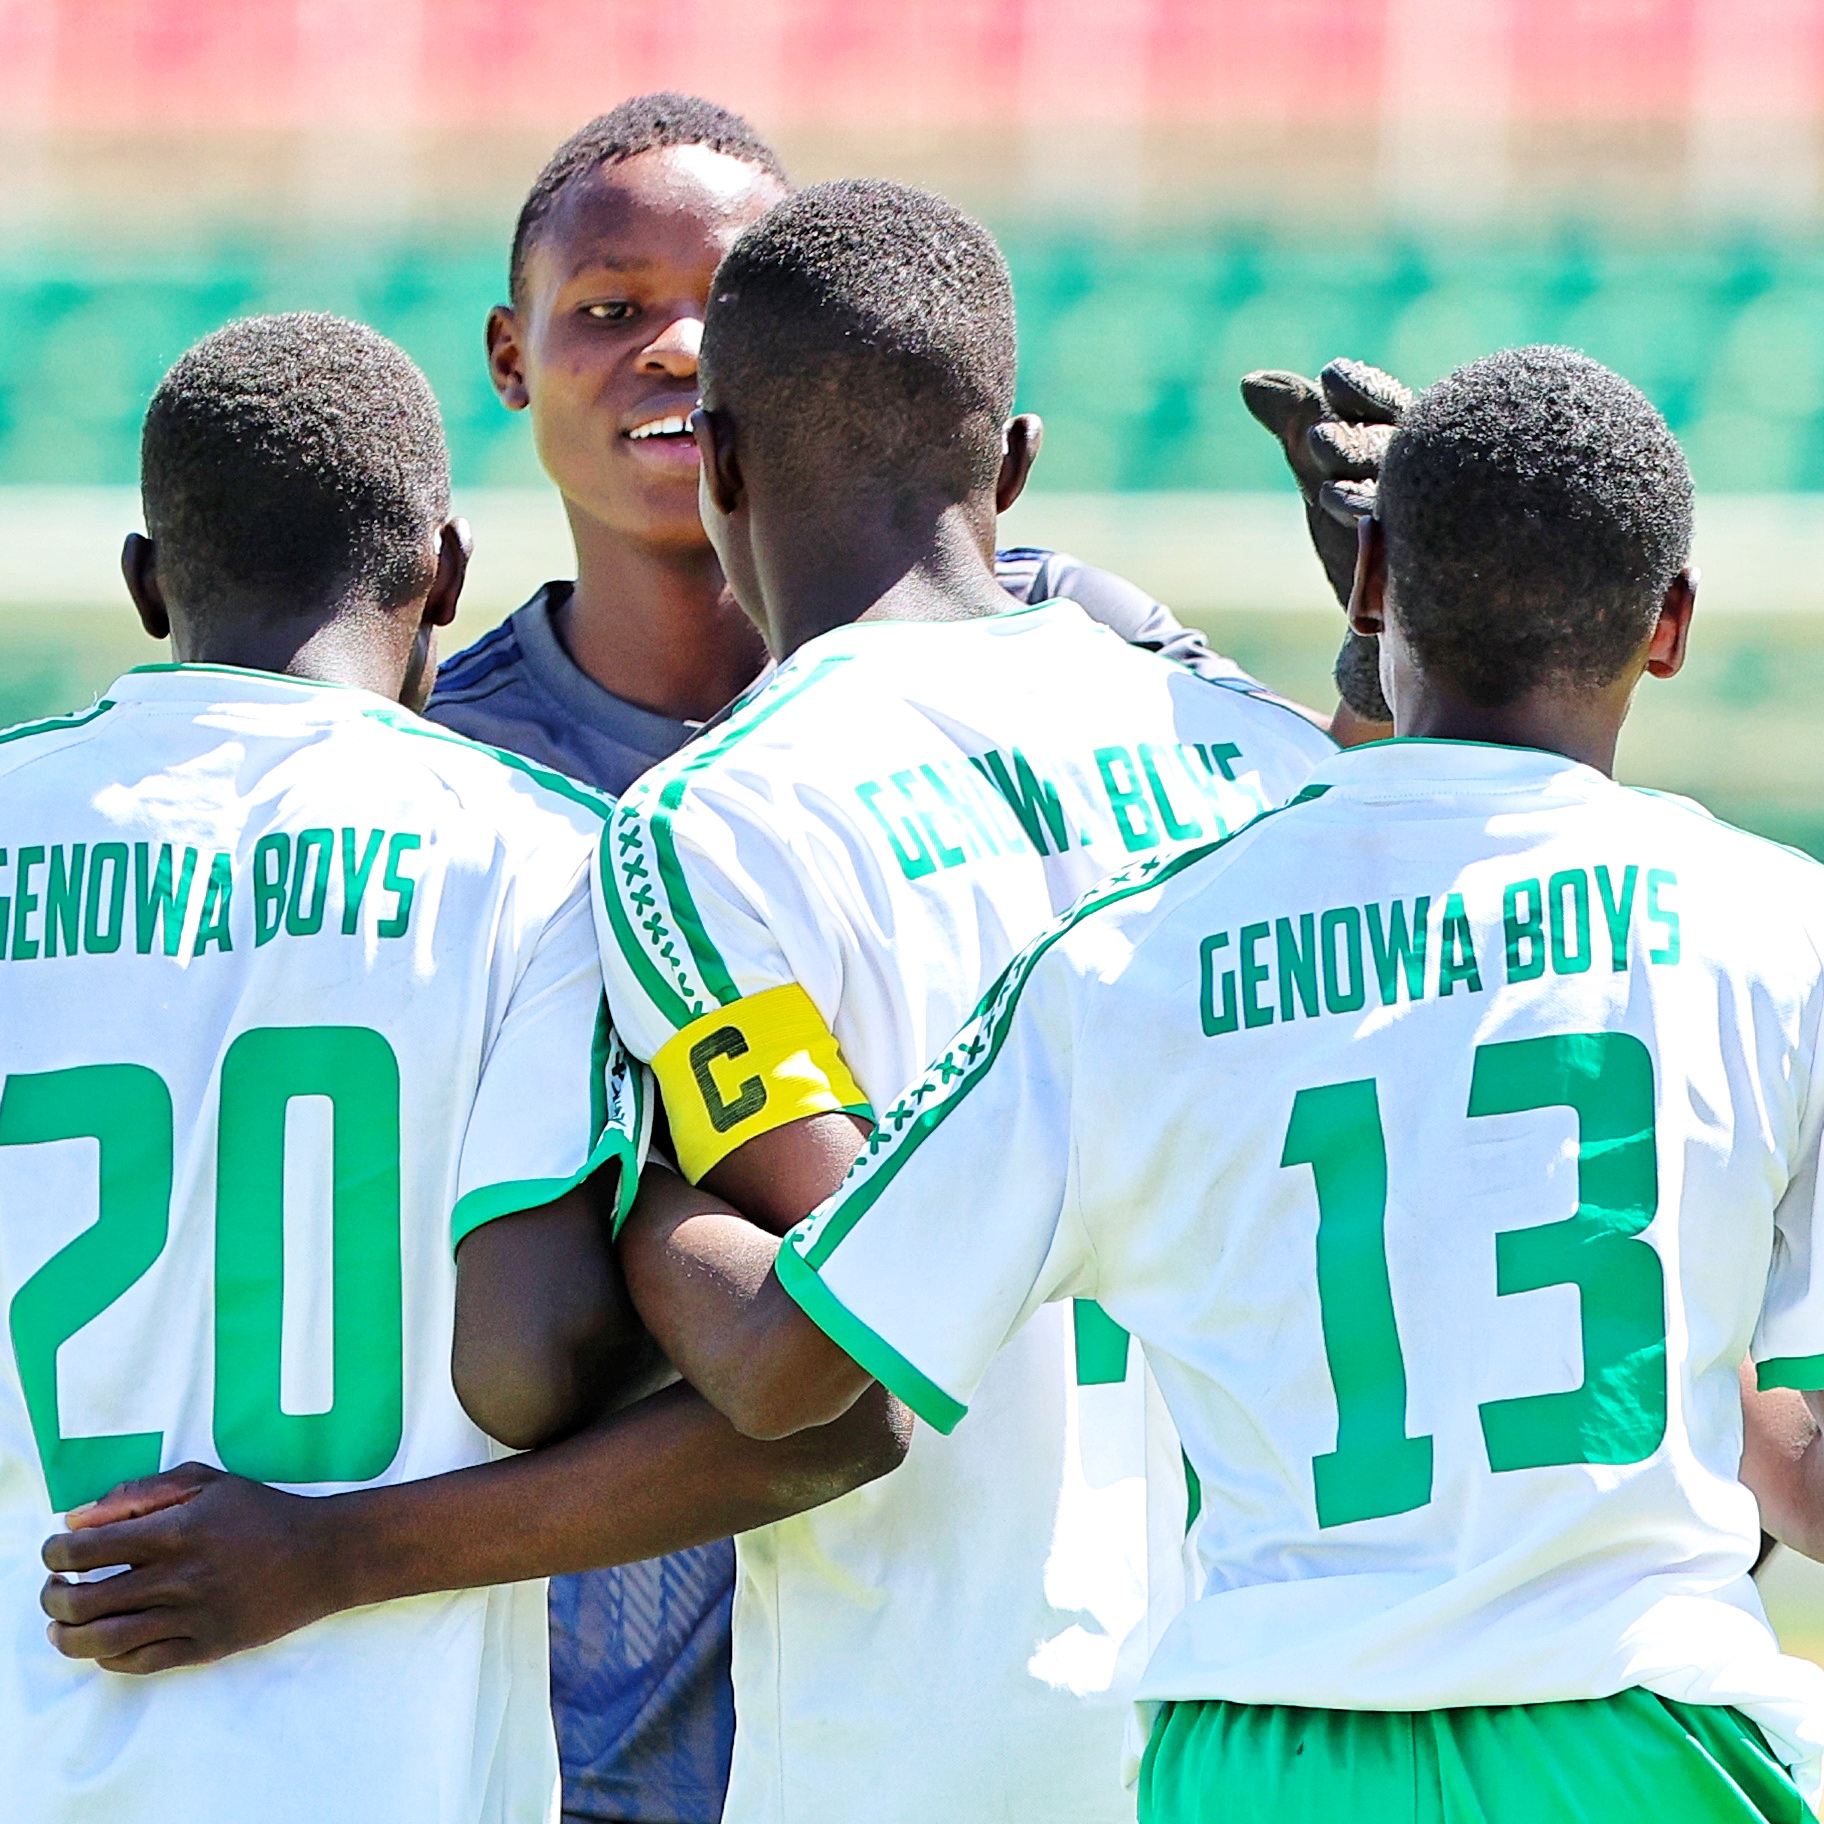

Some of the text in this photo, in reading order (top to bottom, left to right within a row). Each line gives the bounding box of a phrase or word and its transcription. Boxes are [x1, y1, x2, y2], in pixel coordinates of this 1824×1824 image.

[251, 826, 422, 949] BOYS
[1197, 864, 1681, 1038] GENOWA BOYS
[689, 1025, 767, 1133] C
[1277, 1028, 1669, 1530] 13
